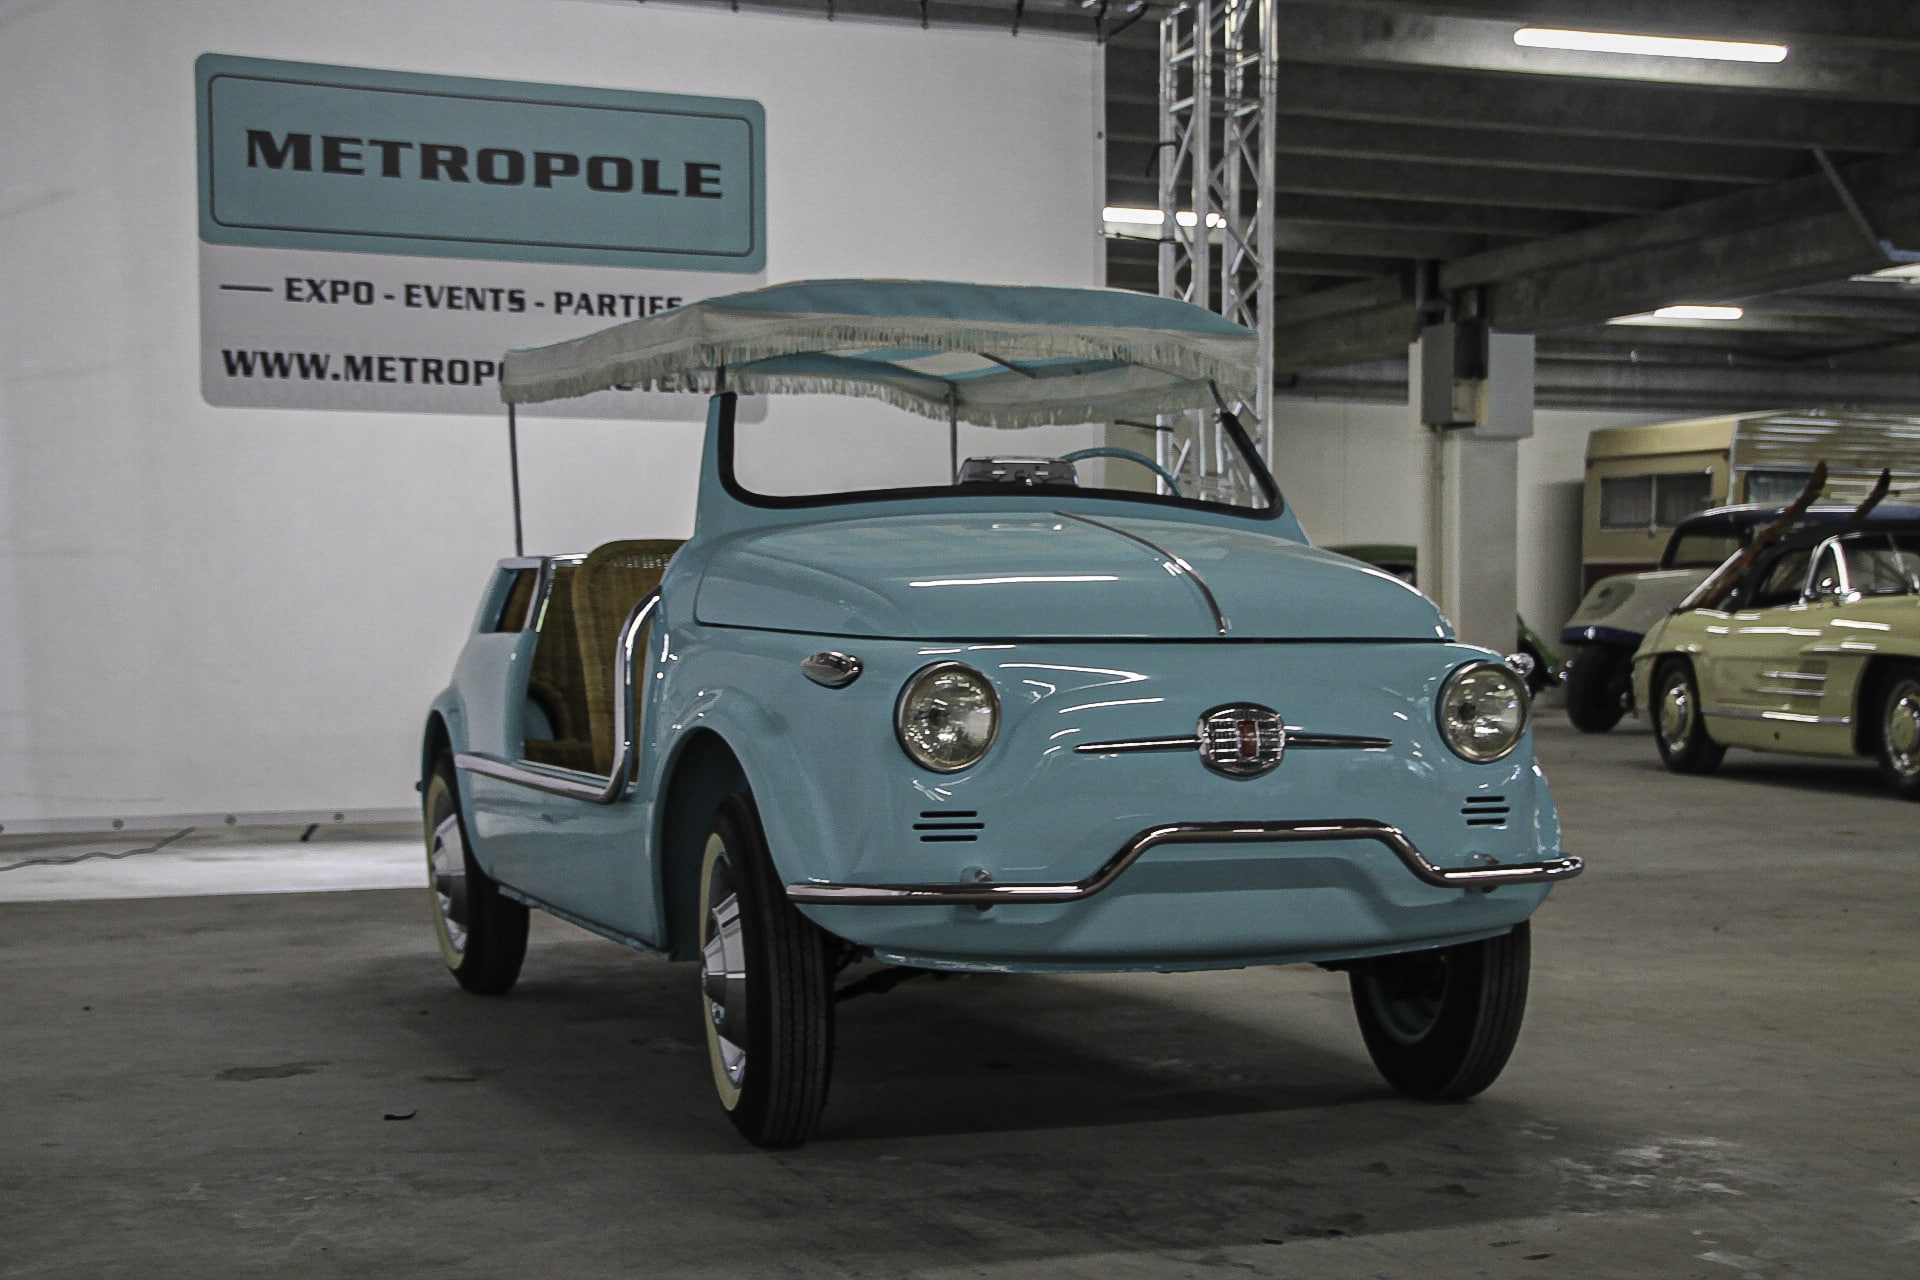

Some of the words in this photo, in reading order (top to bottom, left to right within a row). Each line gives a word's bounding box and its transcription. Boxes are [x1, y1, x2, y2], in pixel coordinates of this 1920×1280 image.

[246, 129, 722, 199] METROPOLE
[285, 277, 375, 305] EXPO
[405, 284, 526, 313] EVENTS
[221, 349, 504, 386] WWW.METROP
